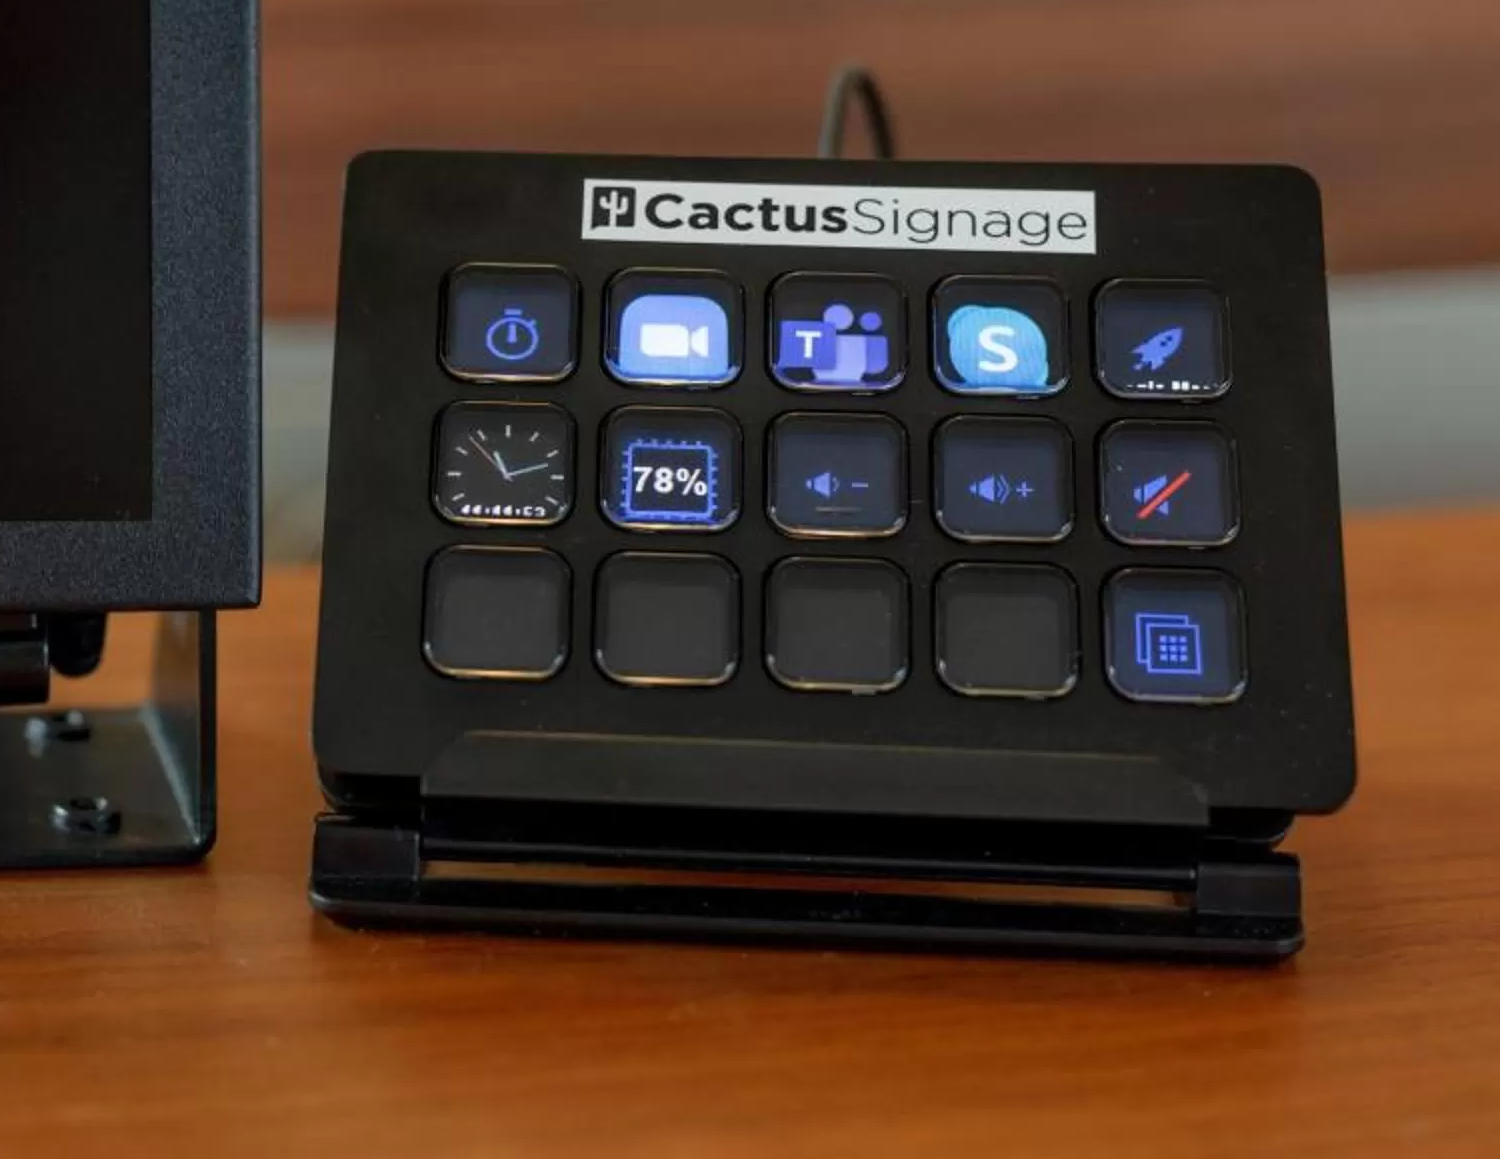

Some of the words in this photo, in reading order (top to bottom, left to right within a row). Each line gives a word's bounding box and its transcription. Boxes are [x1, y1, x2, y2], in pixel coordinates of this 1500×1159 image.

[644, 192, 1088, 246] CactusSignage
[795, 330, 821, 359] T
[978, 324, 1018, 373] S
[633, 466, 708, 496] 78%
